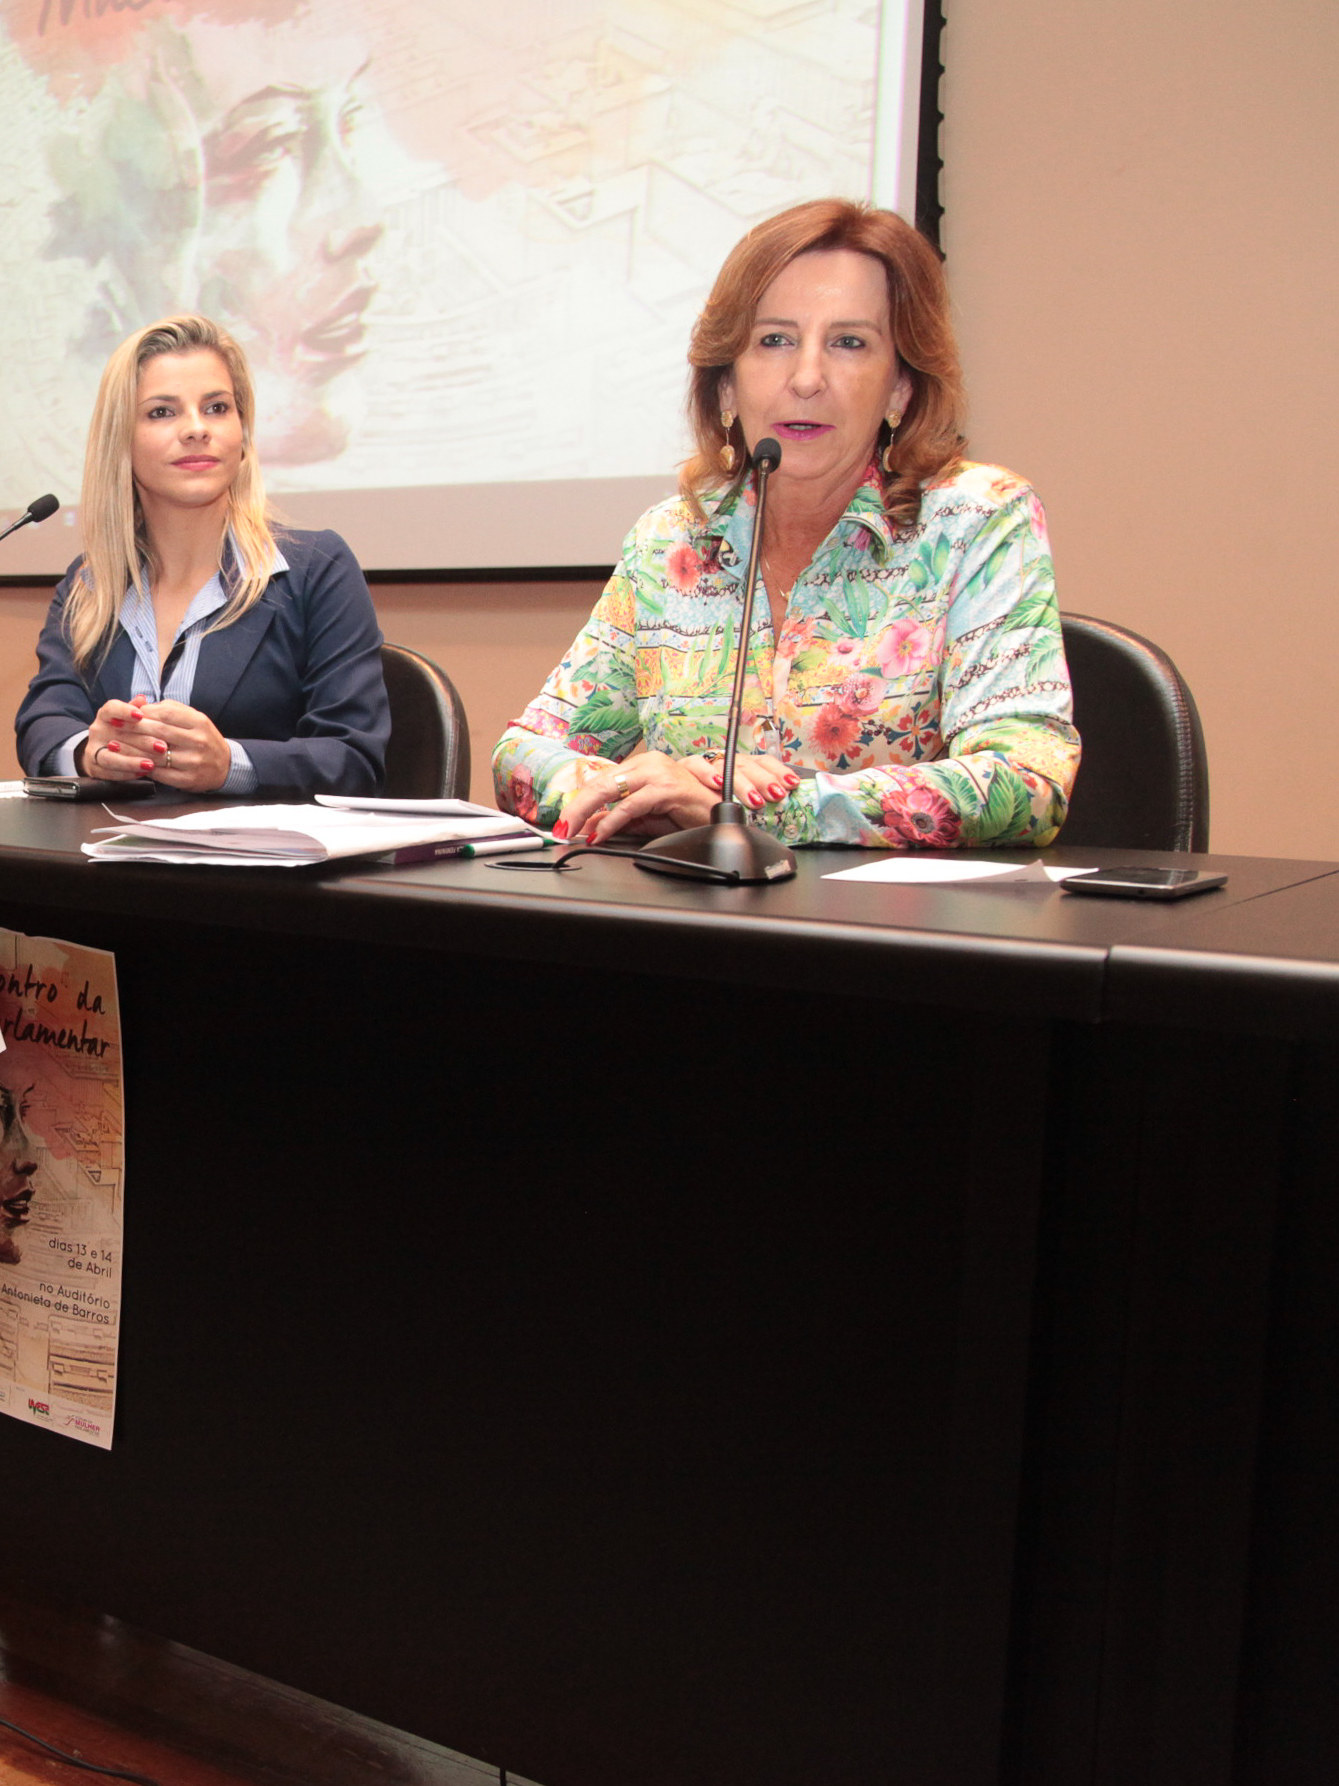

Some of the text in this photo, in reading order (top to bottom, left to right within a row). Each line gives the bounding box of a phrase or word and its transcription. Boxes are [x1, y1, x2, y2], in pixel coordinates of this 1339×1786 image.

[76, 980, 106, 1015] da
[49, 1238, 112, 1262] dias 13 e 14
[68, 1257, 112, 1279] de Abril
[1, 1283, 110, 1325] Antonieta de Barros
[39, 1282, 111, 1309] no Auditório
